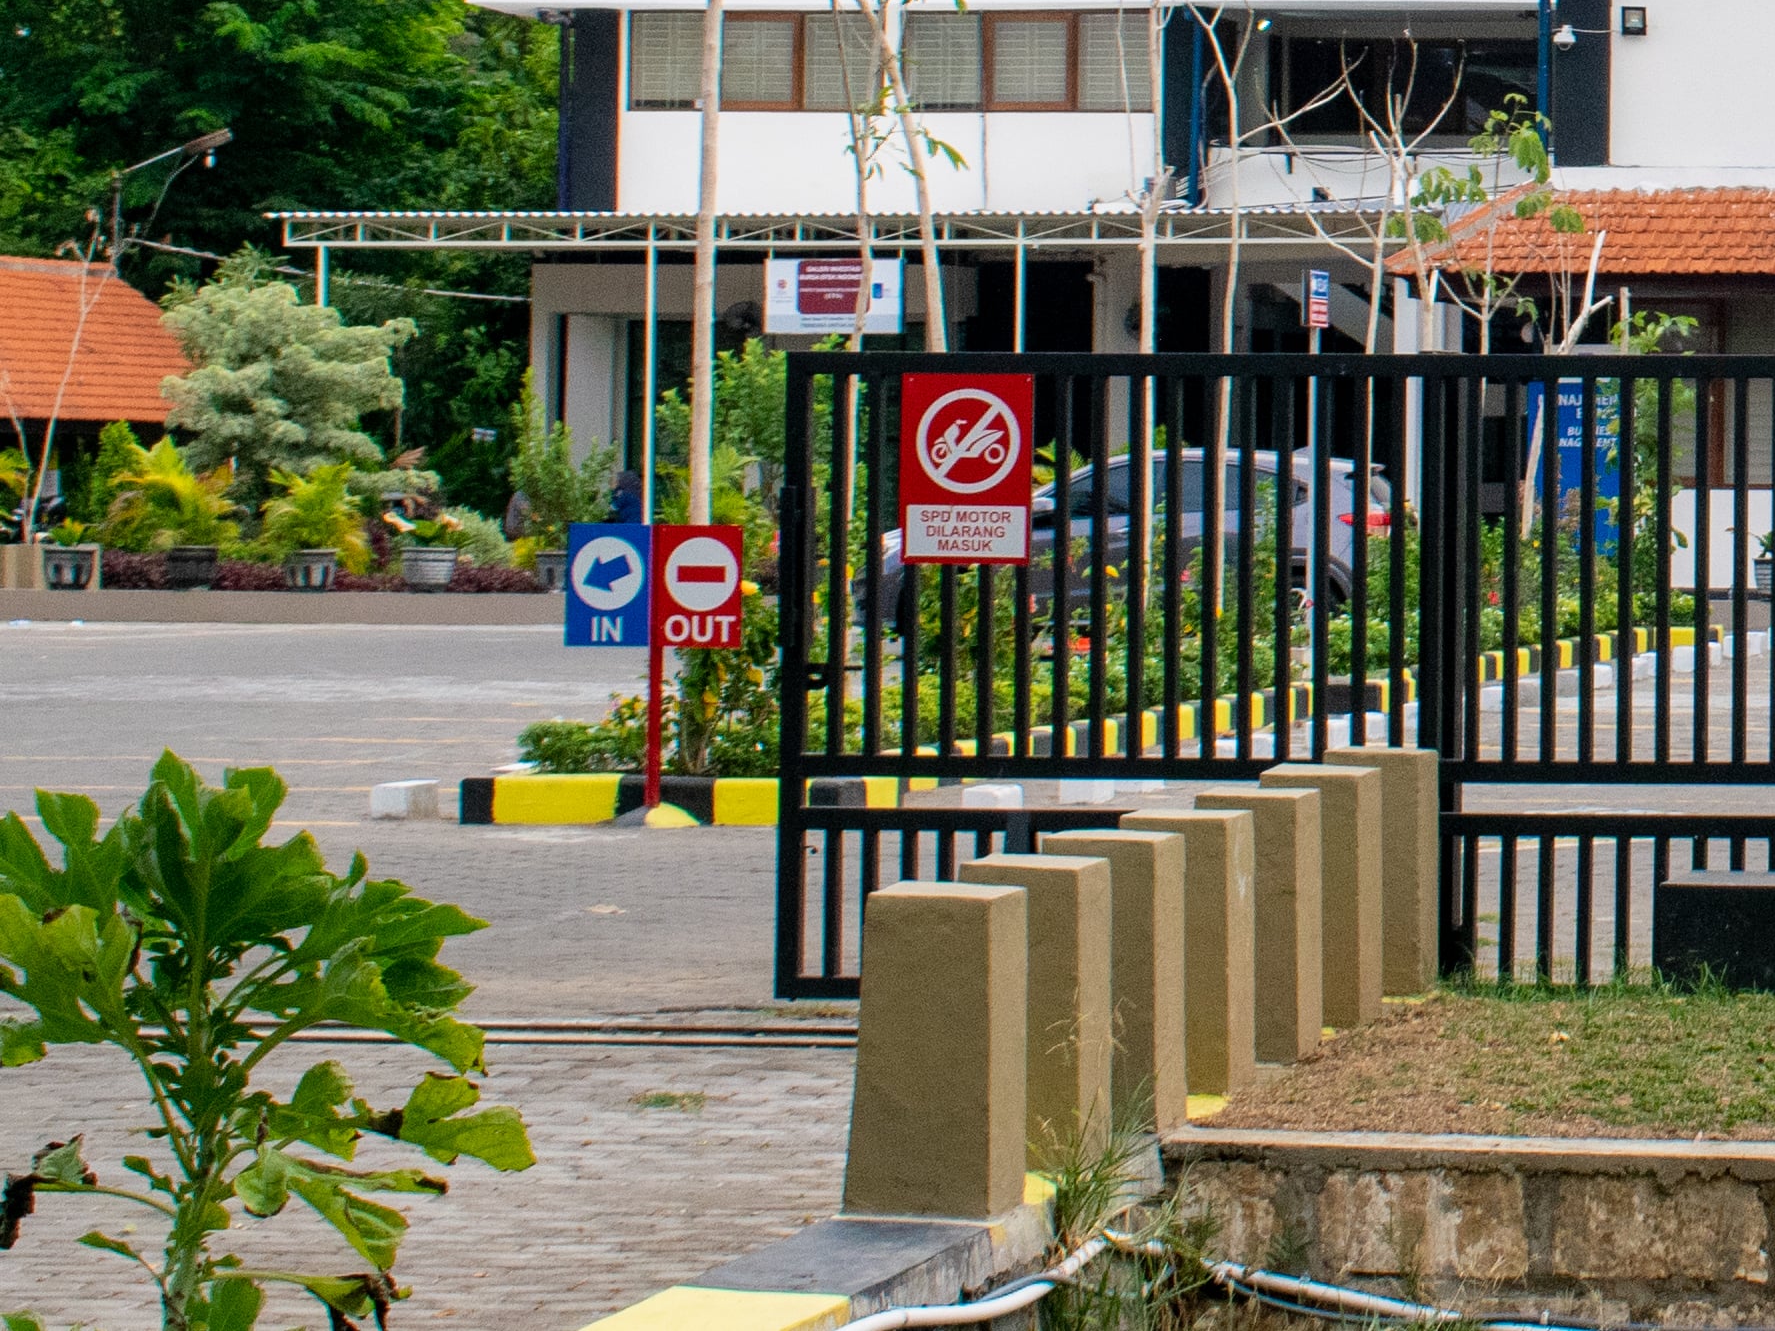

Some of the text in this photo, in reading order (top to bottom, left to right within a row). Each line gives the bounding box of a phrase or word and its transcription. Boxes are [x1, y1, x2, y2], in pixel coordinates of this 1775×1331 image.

[920, 510, 1011, 524] SPD MOTOR
[926, 525, 1006, 538] DILARANG
[938, 540, 992, 552] MASUK
[590, 615, 623, 643] IN
[664, 614, 737, 643] OUT
